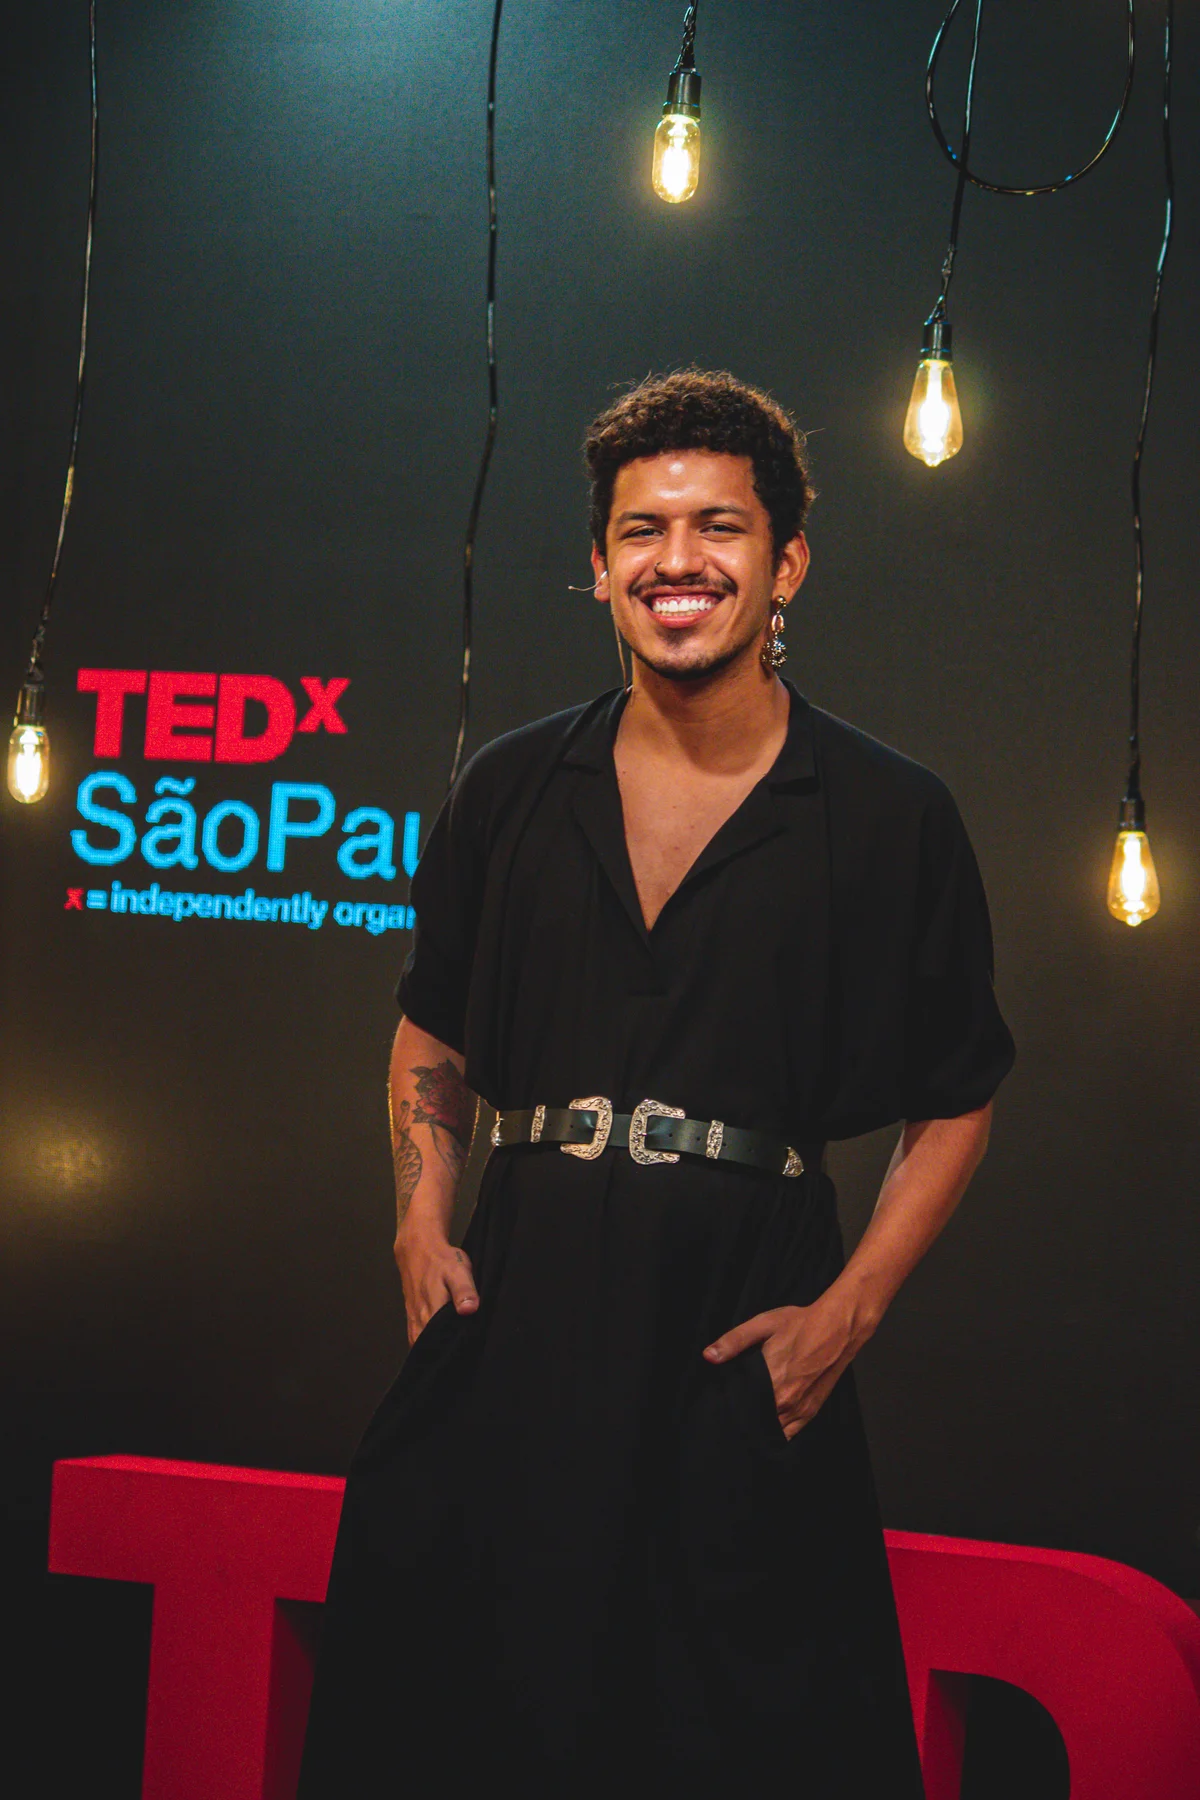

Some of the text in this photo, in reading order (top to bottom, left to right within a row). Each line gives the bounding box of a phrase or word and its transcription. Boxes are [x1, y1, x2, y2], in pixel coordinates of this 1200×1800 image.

[77, 668, 350, 764] TEDx
[110, 880, 329, 930] independently
[48, 1454, 1200, 1800] TD
